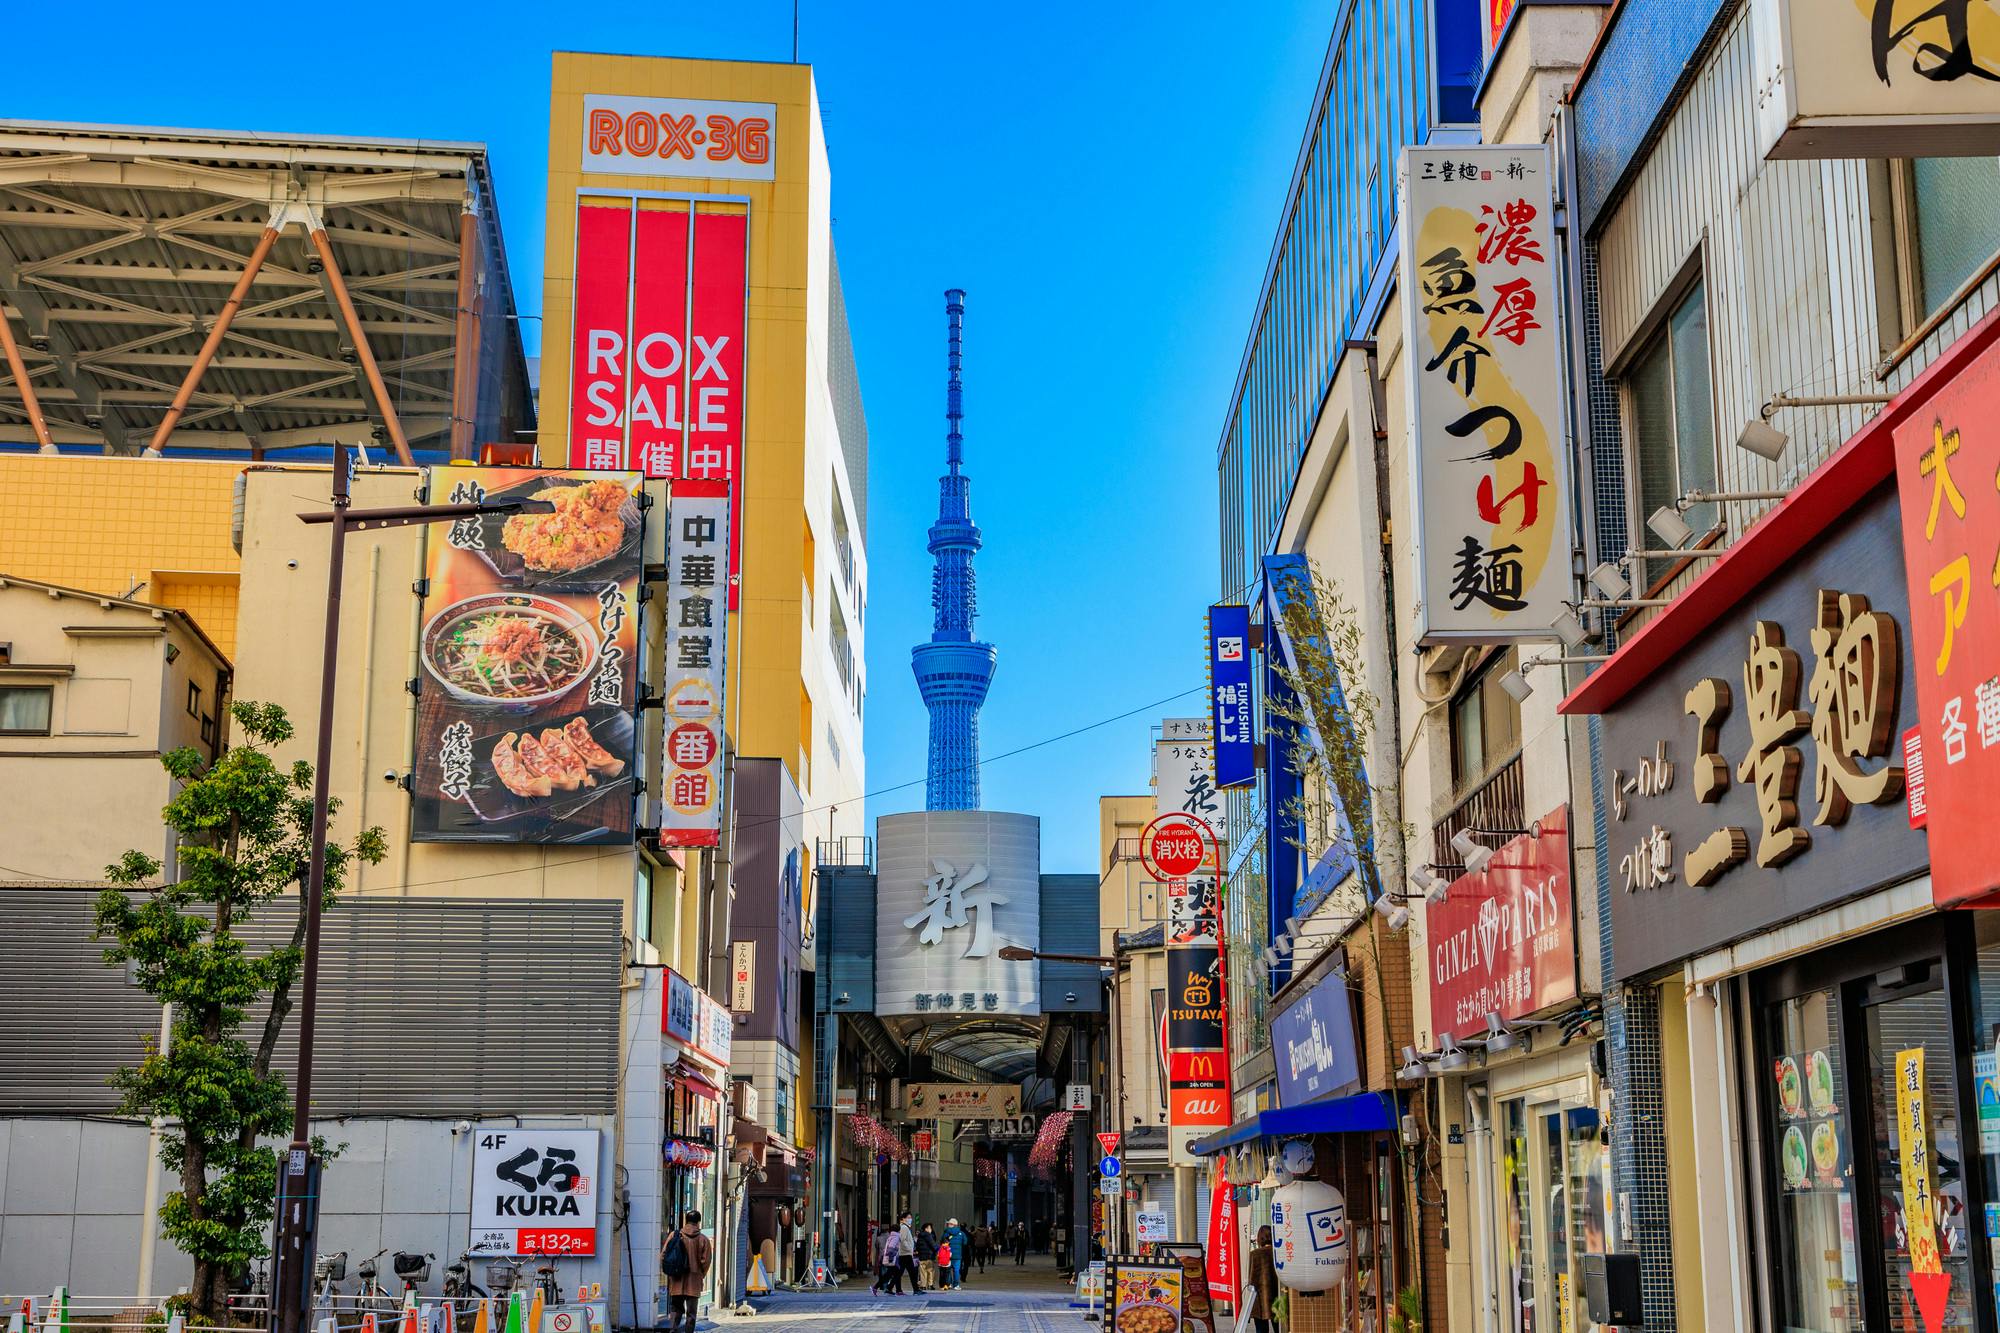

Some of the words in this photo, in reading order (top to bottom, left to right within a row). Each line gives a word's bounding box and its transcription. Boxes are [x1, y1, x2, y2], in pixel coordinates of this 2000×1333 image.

[1476, 198, 1545, 347] 濃厚
[587, 328, 731, 381] ROX
[585, 381, 729, 433] SALE
[677, 514, 715, 669] 中華食堂
[1217, 685, 1237, 743] 福しん
[1237, 682, 1249, 743] FUKUSHIN
[1685, 589, 1903, 887] 三豊麺
[673, 699, 710, 806] 一番館
[1614, 740, 1674, 822] らーめん
[1155, 838, 1200, 860] 消火栓
[1620, 825, 1676, 894] つけ麺
[904, 859, 1010, 958] 新
[1436, 924, 1479, 985] GINZA
[1501, 875, 1558, 951] PARIS
[739, 944, 747, 970] とんかつ
[915, 992, 999, 1011] 新仲見世
[1172, 1009, 1223, 1020] TSUTAYA
[1184, 1099, 1221, 1115] au
[481, 1135, 507, 1150] 4F
[1905, 1059, 1929, 1214] 謹賀新年
[496, 1147, 581, 1193] くら
[496, 1195, 580, 1216] KURA
[1284, 1202, 1293, 1238] ラーメン
[1272, 1202, 1284, 1270] 福しん
